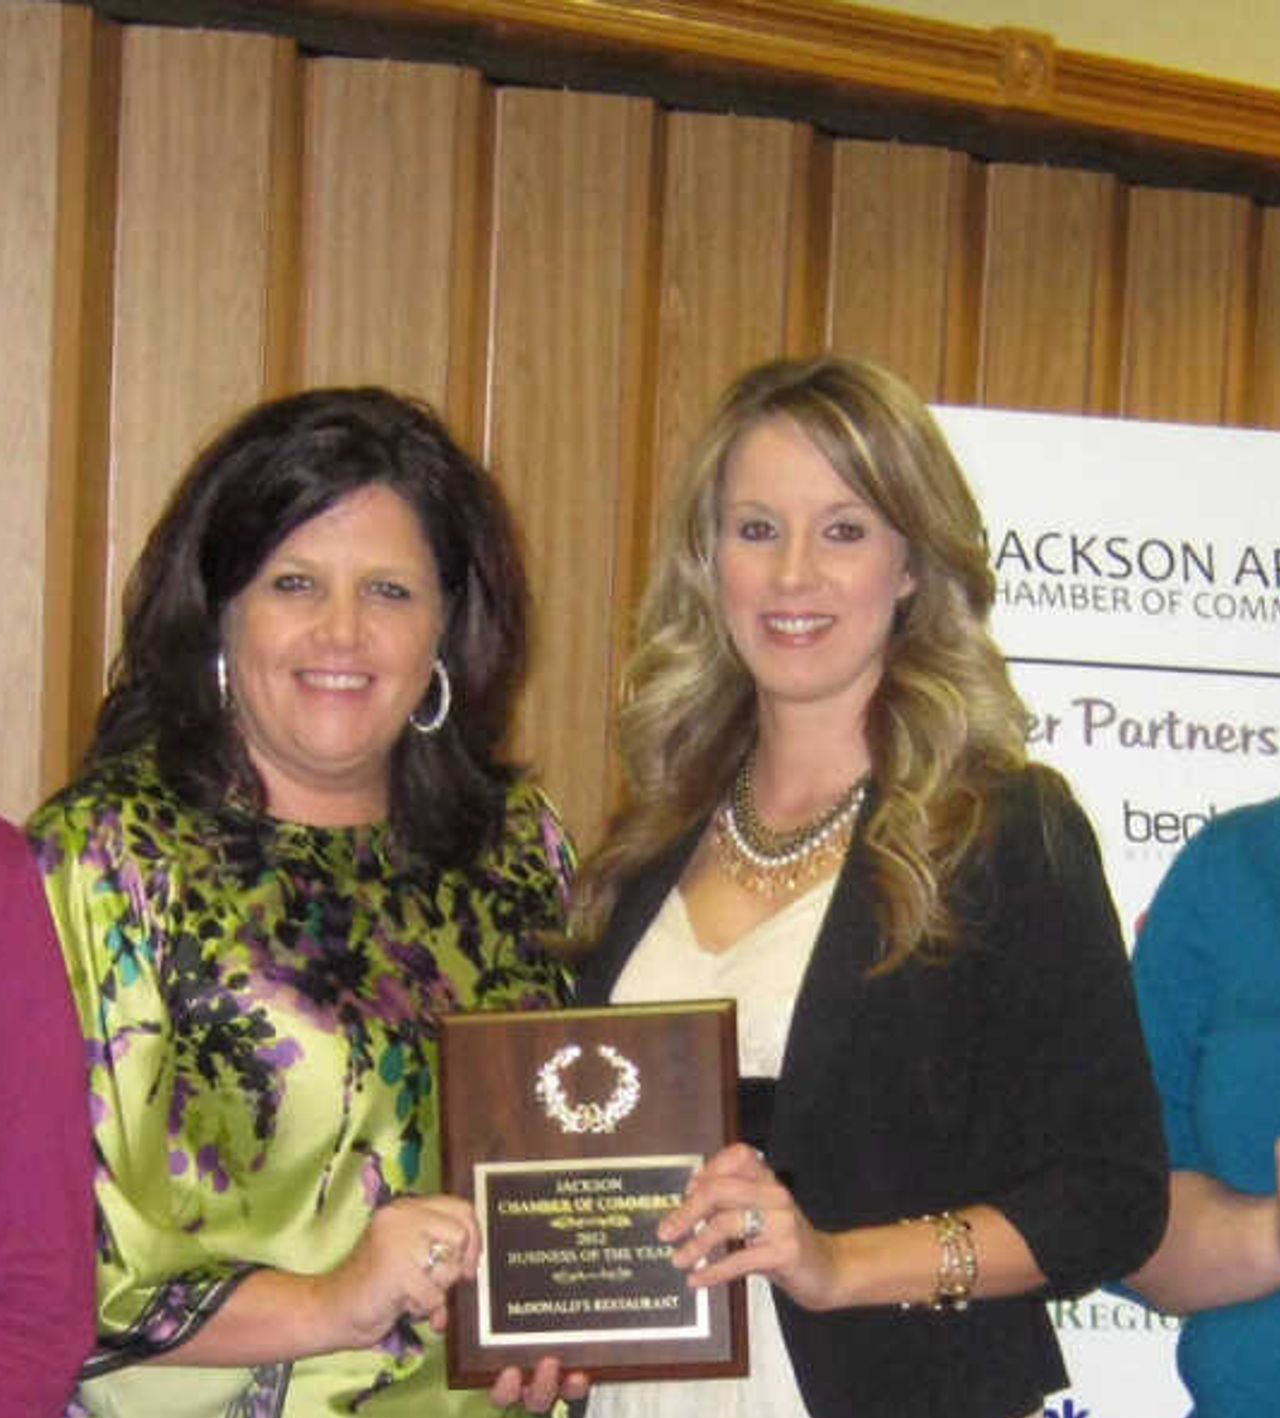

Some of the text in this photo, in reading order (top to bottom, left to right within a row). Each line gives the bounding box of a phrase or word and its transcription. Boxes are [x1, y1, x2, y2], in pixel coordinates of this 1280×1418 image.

[998, 580, 1133, 613] HAMBER
[1141, 588, 1183, 616] OF
[1024, 697, 1280, 756] er Partners
